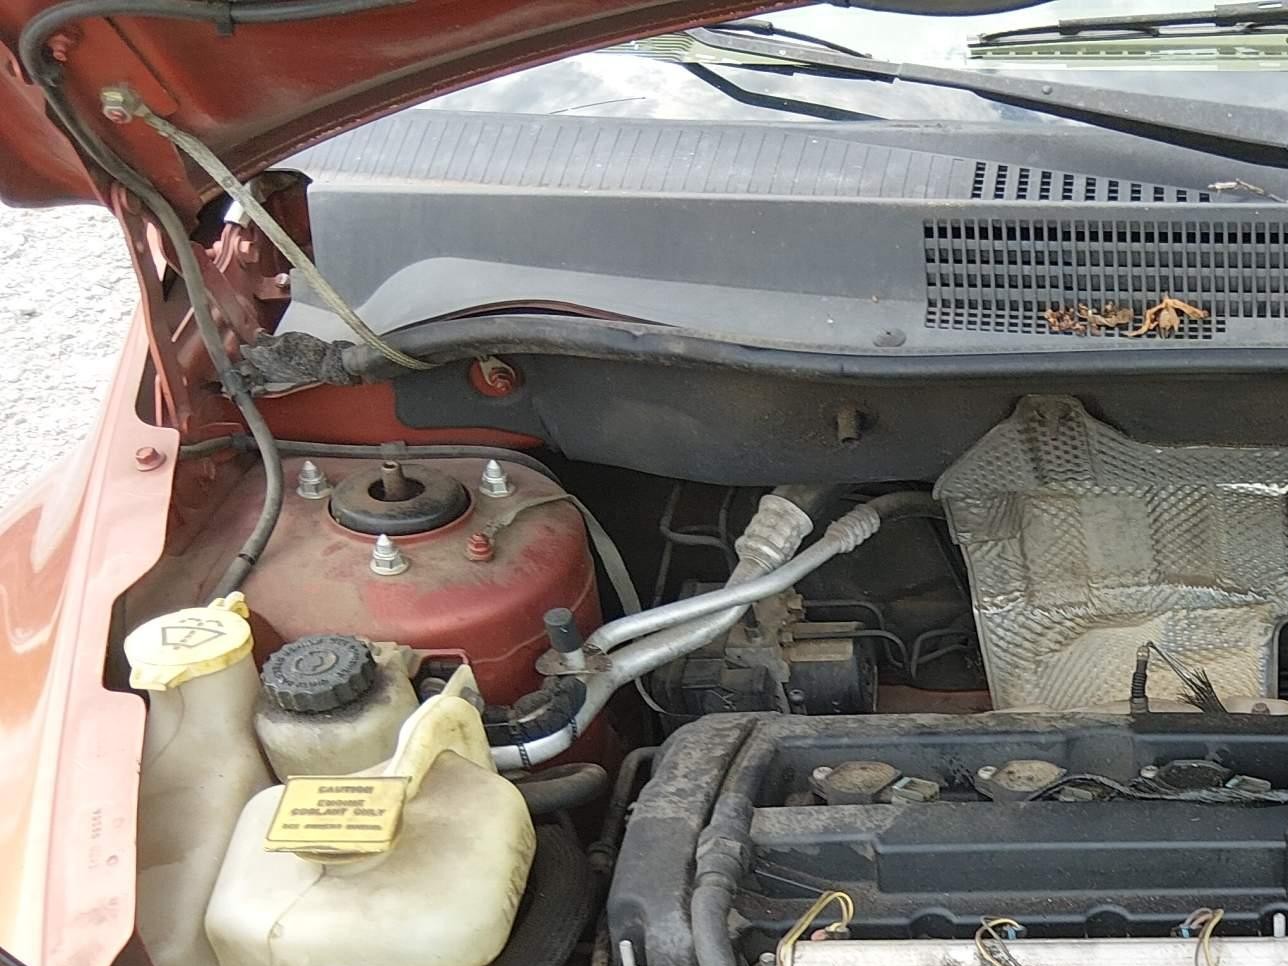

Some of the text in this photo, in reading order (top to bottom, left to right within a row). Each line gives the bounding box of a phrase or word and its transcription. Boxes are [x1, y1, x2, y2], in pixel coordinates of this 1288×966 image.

[317, 785, 374, 794] CAUTION
[316, 799, 366, 807] ENGINE
[290, 808, 387, 816] COOLANT ONLY
